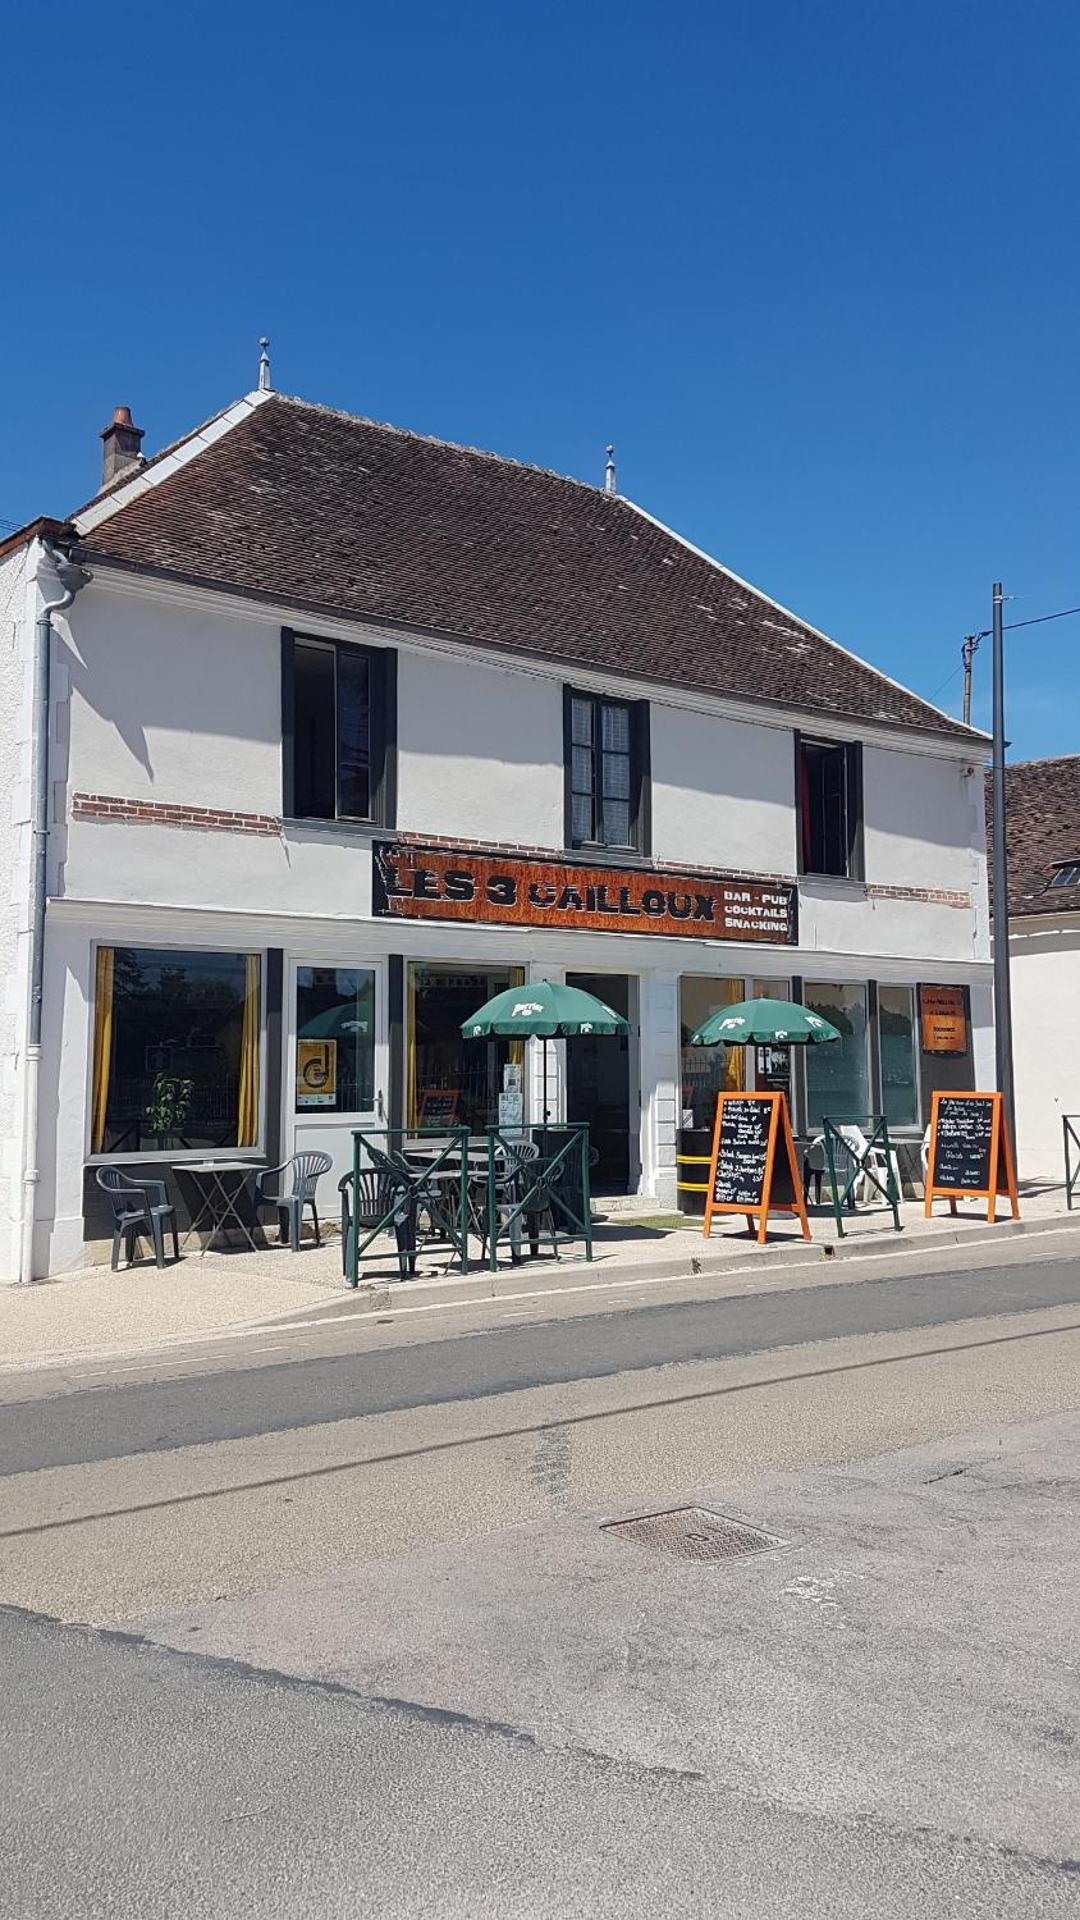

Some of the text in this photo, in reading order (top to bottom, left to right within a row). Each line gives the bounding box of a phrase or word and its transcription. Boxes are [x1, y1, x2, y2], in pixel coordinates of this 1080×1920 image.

[384, 868, 716, 923] LES 3 CAILLOUX
[724, 891, 751, 902] BAR
[762, 894, 788, 906] PUB
[724, 906, 788, 919] COCKTAILS
[724, 918, 788, 932] SNACKING
